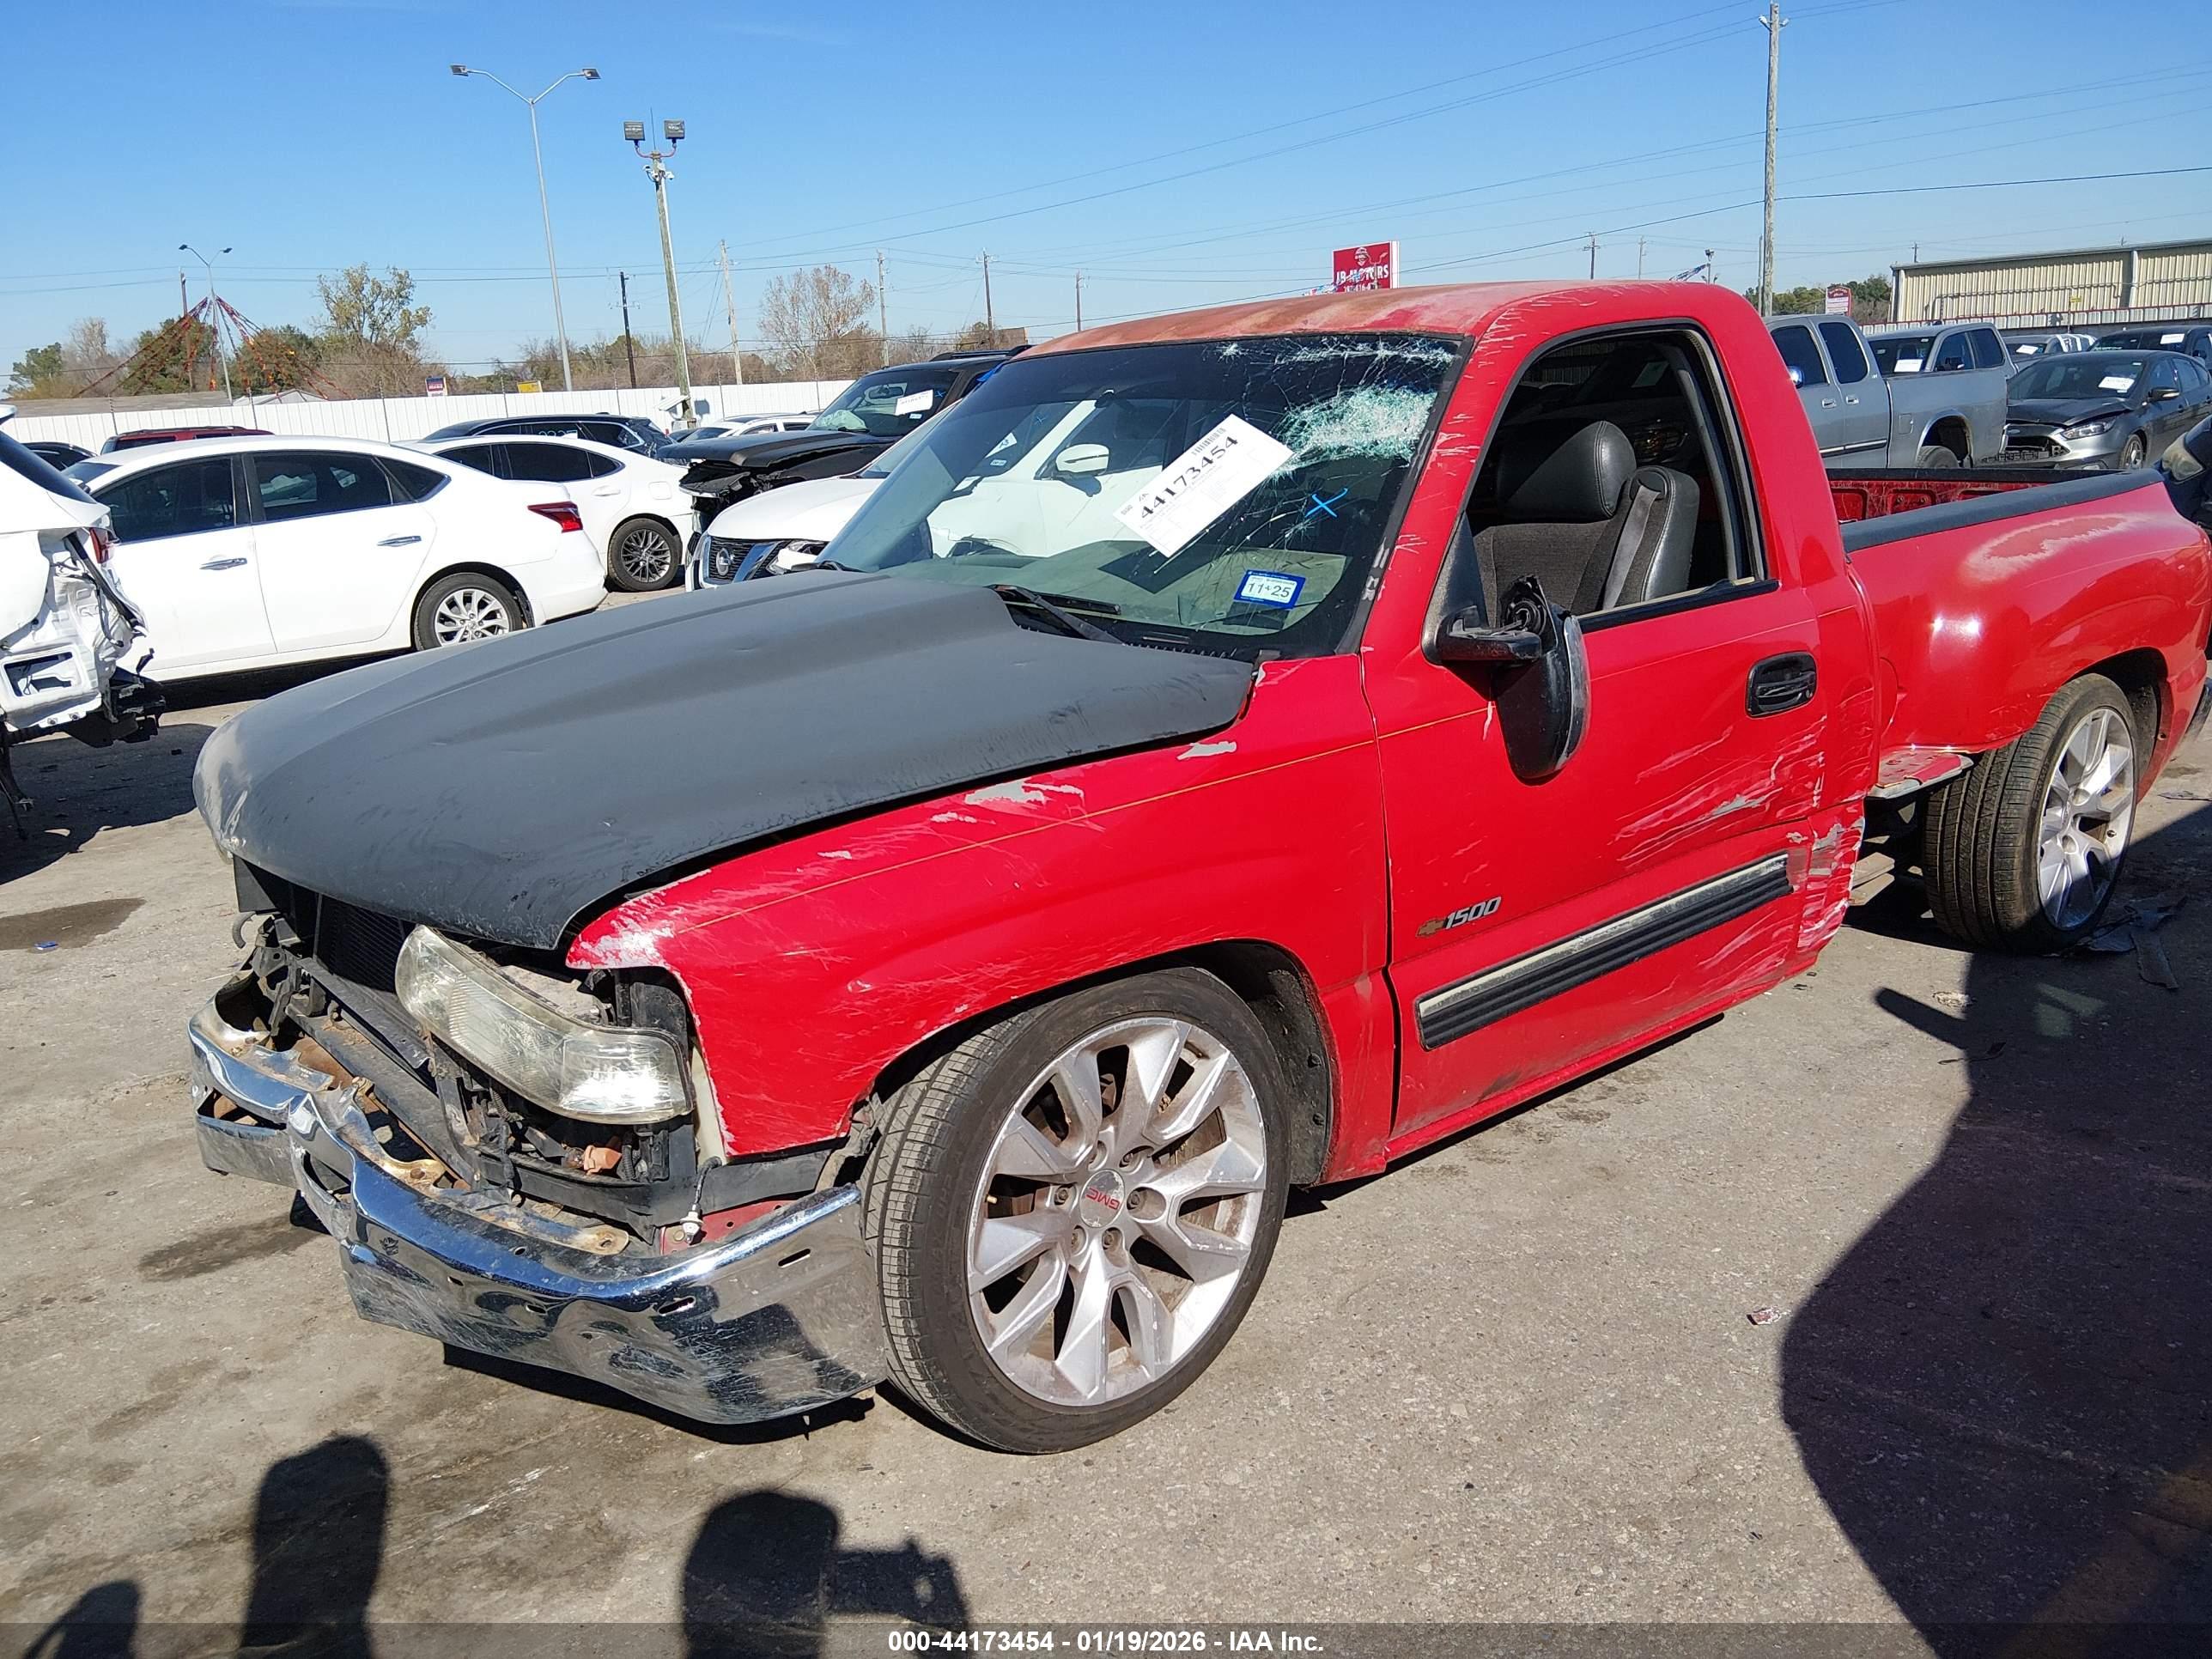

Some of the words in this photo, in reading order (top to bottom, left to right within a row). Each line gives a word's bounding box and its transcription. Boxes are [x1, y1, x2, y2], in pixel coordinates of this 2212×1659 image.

[1141, 435, 1238, 519] 44173454
[1445, 896, 1502, 929] 1500
[1085, 1184, 1121, 1211] GMC
